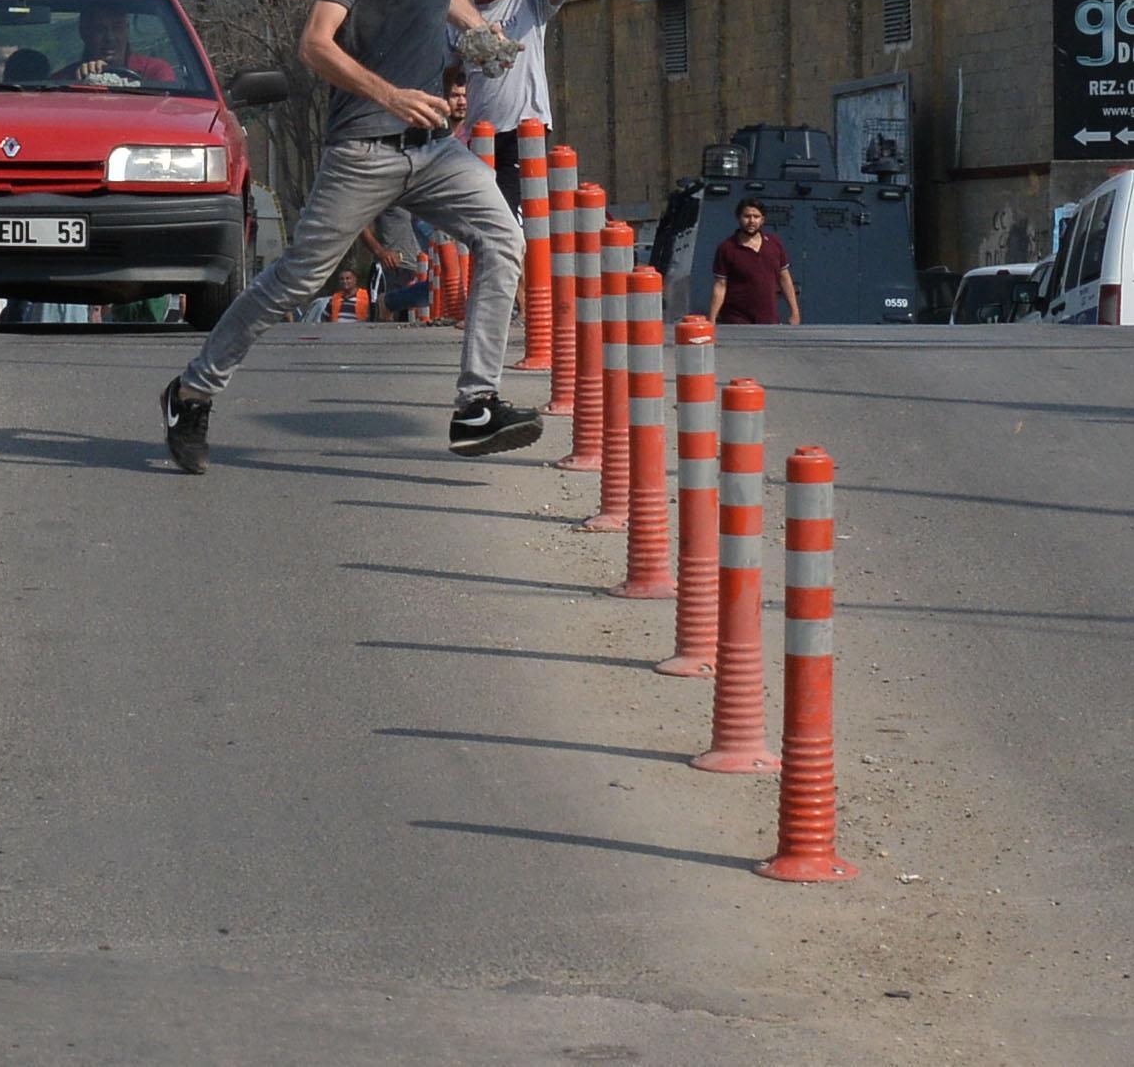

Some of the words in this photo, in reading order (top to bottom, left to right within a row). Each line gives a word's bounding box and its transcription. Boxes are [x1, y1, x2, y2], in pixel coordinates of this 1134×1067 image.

[1089, 80, 1124, 96] REZ.:
[58, 221, 84, 244] 53
[884, 298, 908, 308] 0559
